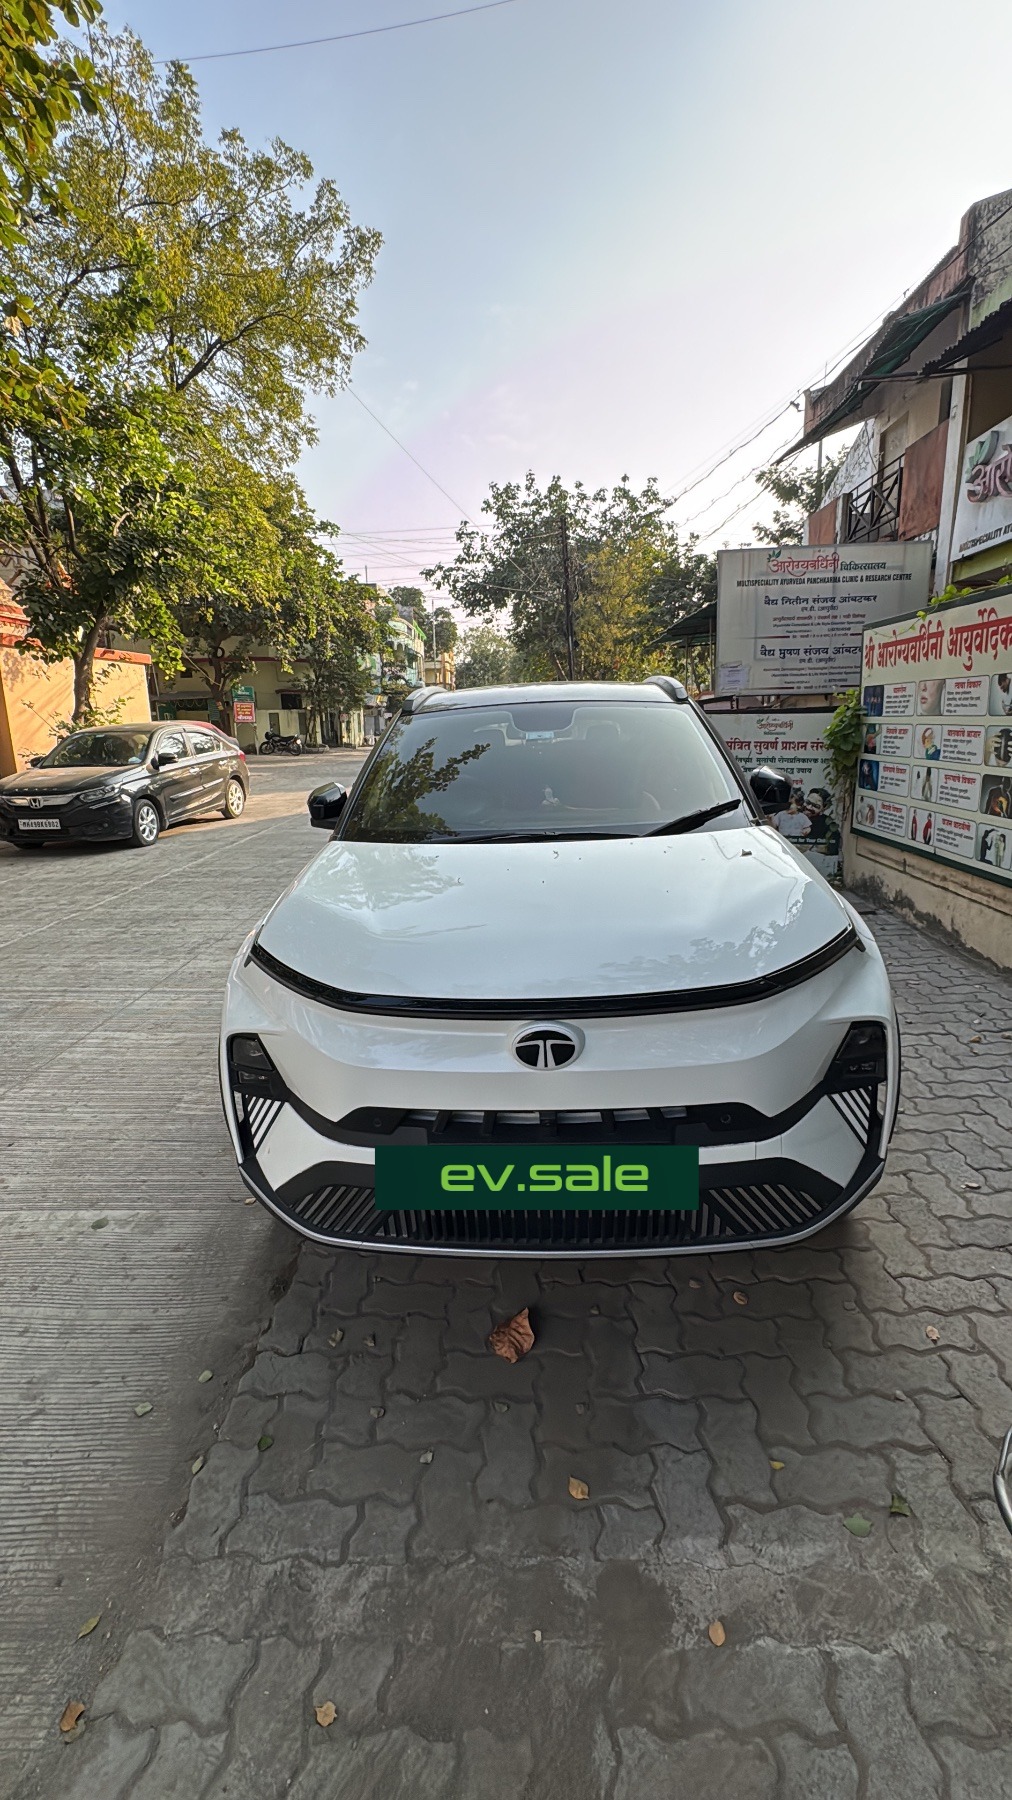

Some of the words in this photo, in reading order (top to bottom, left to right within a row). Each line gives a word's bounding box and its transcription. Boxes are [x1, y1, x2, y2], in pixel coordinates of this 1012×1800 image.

[737, 578, 780, 587] MULTISPECIALITY
[780, 577, 806, 585] AYURVEDA
[807, 575, 841, 584] PANCHKARMA
[842, 575, 859, 583] CLINIC
[865, 574, 892, 582] RESEARCH
[893, 573, 912, 581] CENTRE
[781, 595, 809, 605] नितीन
[812, 594, 837, 605] संजय
[804, 645, 829, 656] संजय
[865, 636, 875, 669] श्री
[754, 737, 779, 754] सुवर्ण
[781, 741, 808, 751] प्राशन
